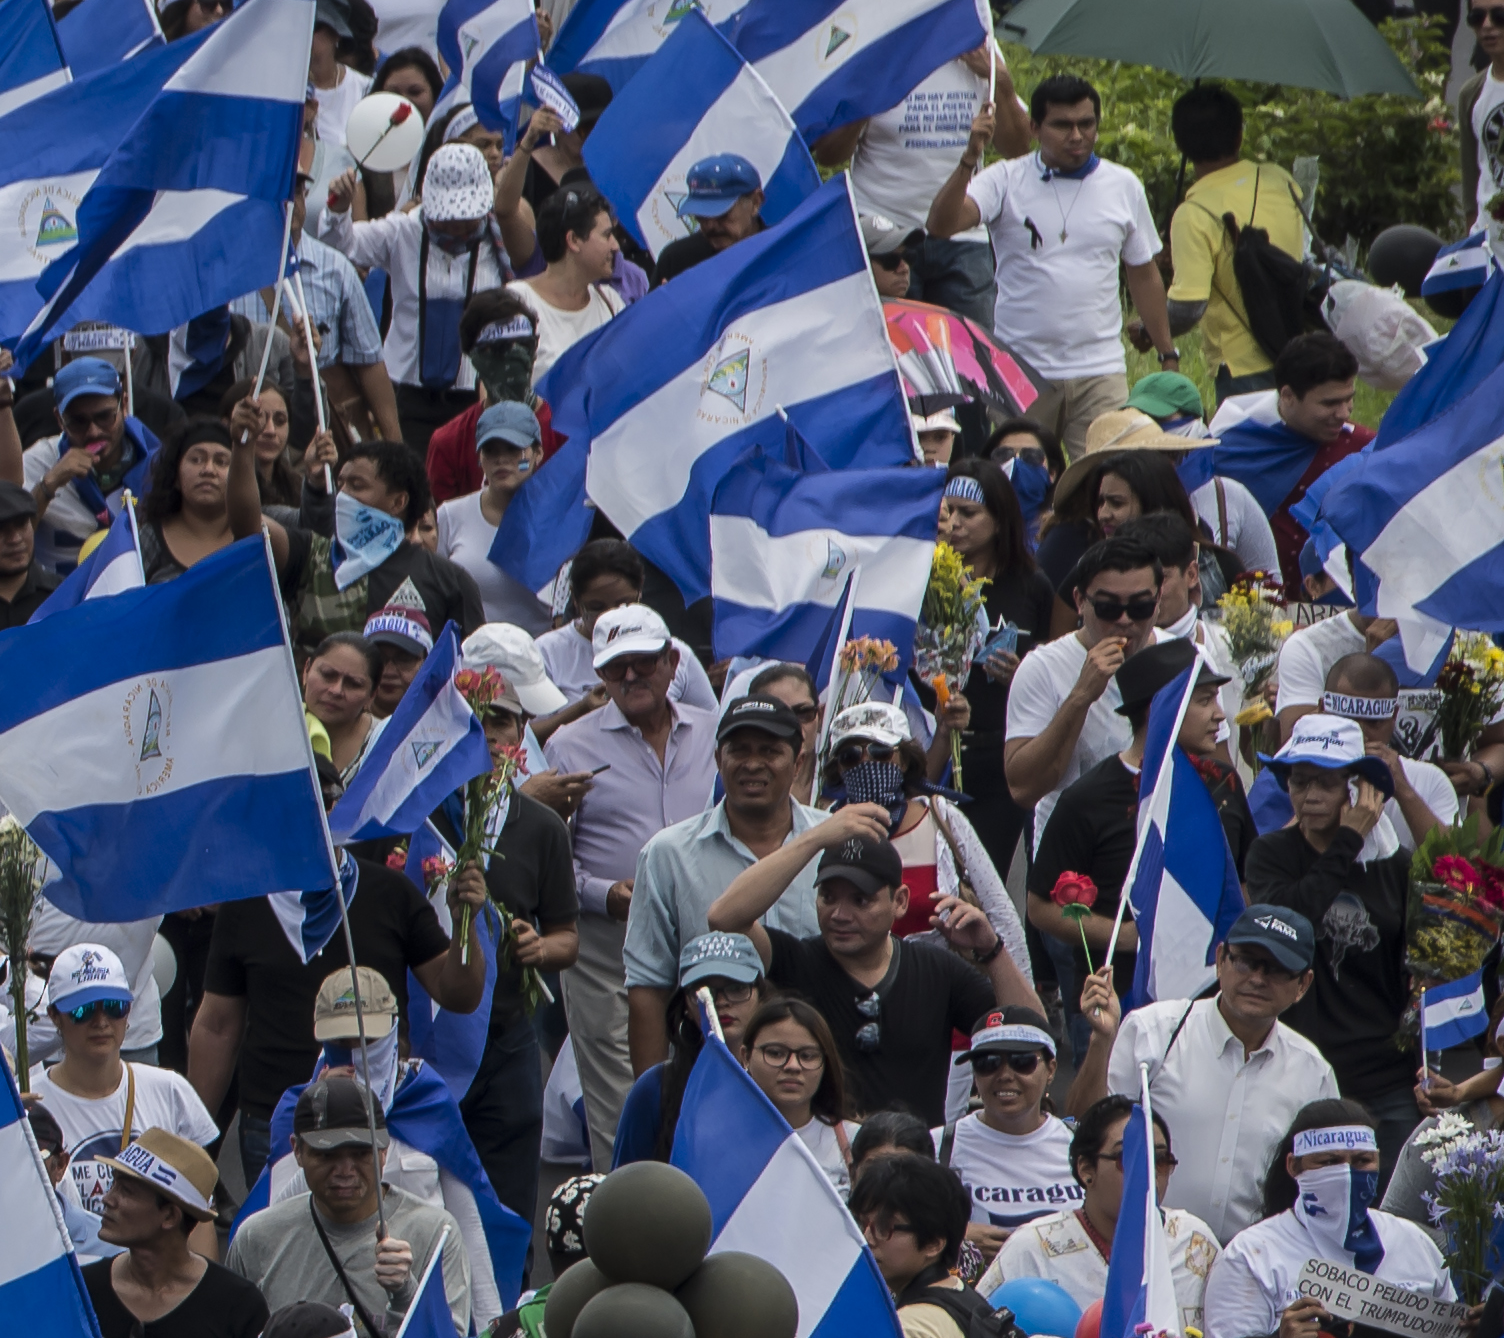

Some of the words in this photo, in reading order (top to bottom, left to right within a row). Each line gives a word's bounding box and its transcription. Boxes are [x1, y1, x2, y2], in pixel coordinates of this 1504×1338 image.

[1332, 697, 1396, 717] NICARAGUA
[1294, 734, 1346, 750] Nicaragua
[1302, 1128, 1371, 1149] Nicaragua
[1298, 1279, 1332, 1302] CON
[1335, 1293, 1353, 1311] EL
[1304, 1258, 1371, 1293] SOBACO
[1374, 1282, 1431, 1317] PELUDO
[1430, 1301, 1448, 1316] TE
